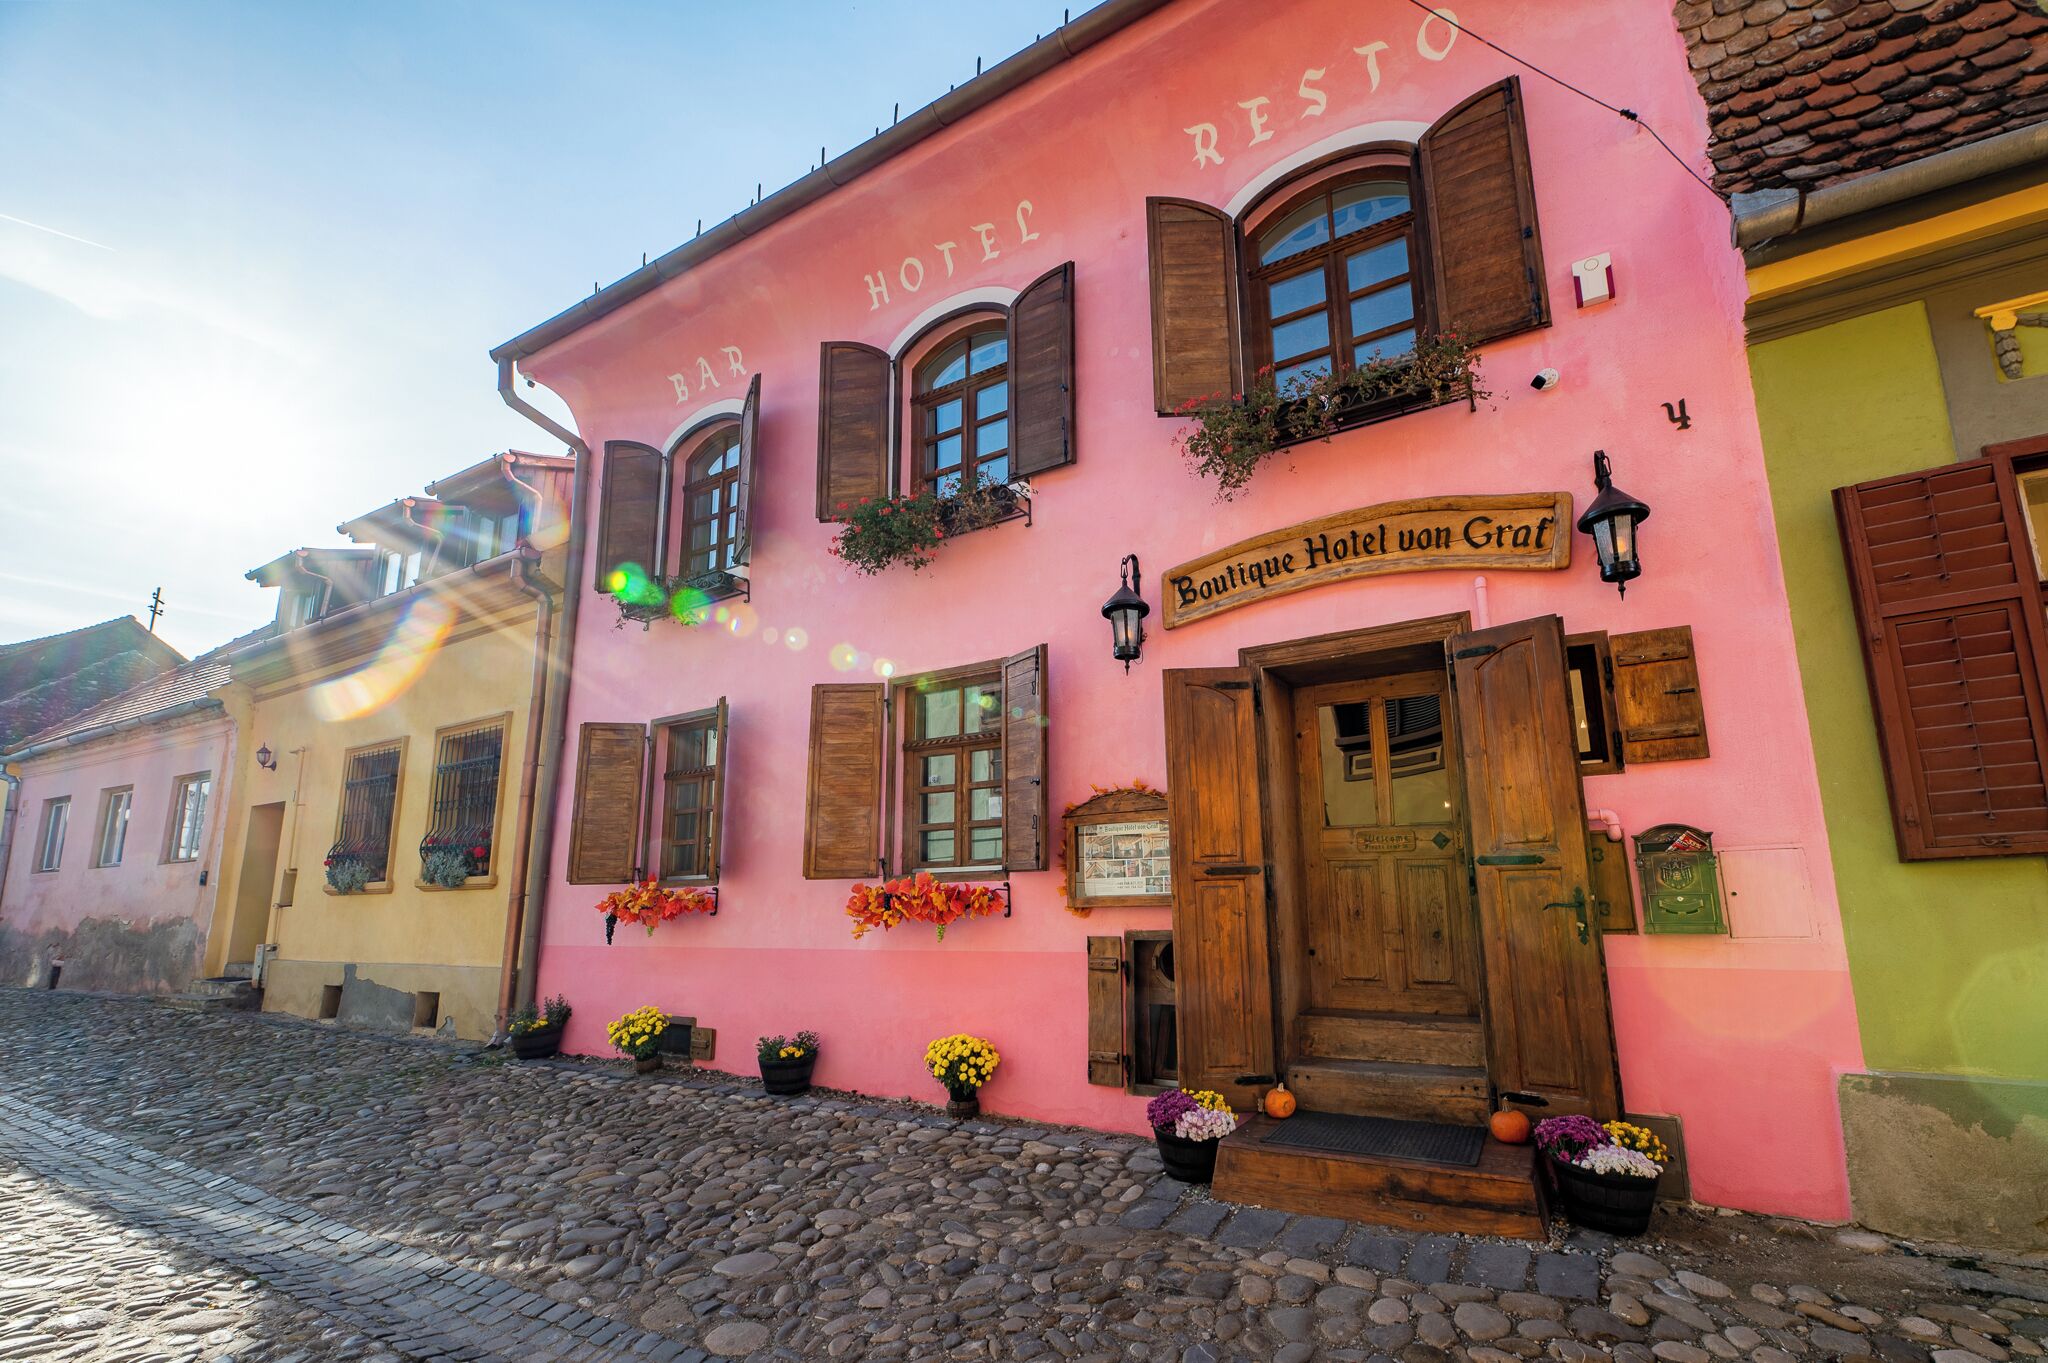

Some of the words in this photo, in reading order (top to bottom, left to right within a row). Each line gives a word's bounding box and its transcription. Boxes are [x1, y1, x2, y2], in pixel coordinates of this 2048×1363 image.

[667, 345, 747, 405] BAR
[864, 199, 1039, 311] HOTEL
[1184, 7, 1460, 169] RESTO
[1169, 552, 1294, 609] Boutique
[1303, 524, 1388, 571] Hotel
[1398, 526, 1451, 551] von
[1463, 515, 1554, 550] Graf
[1124, 823, 1136, 831] Hotel
